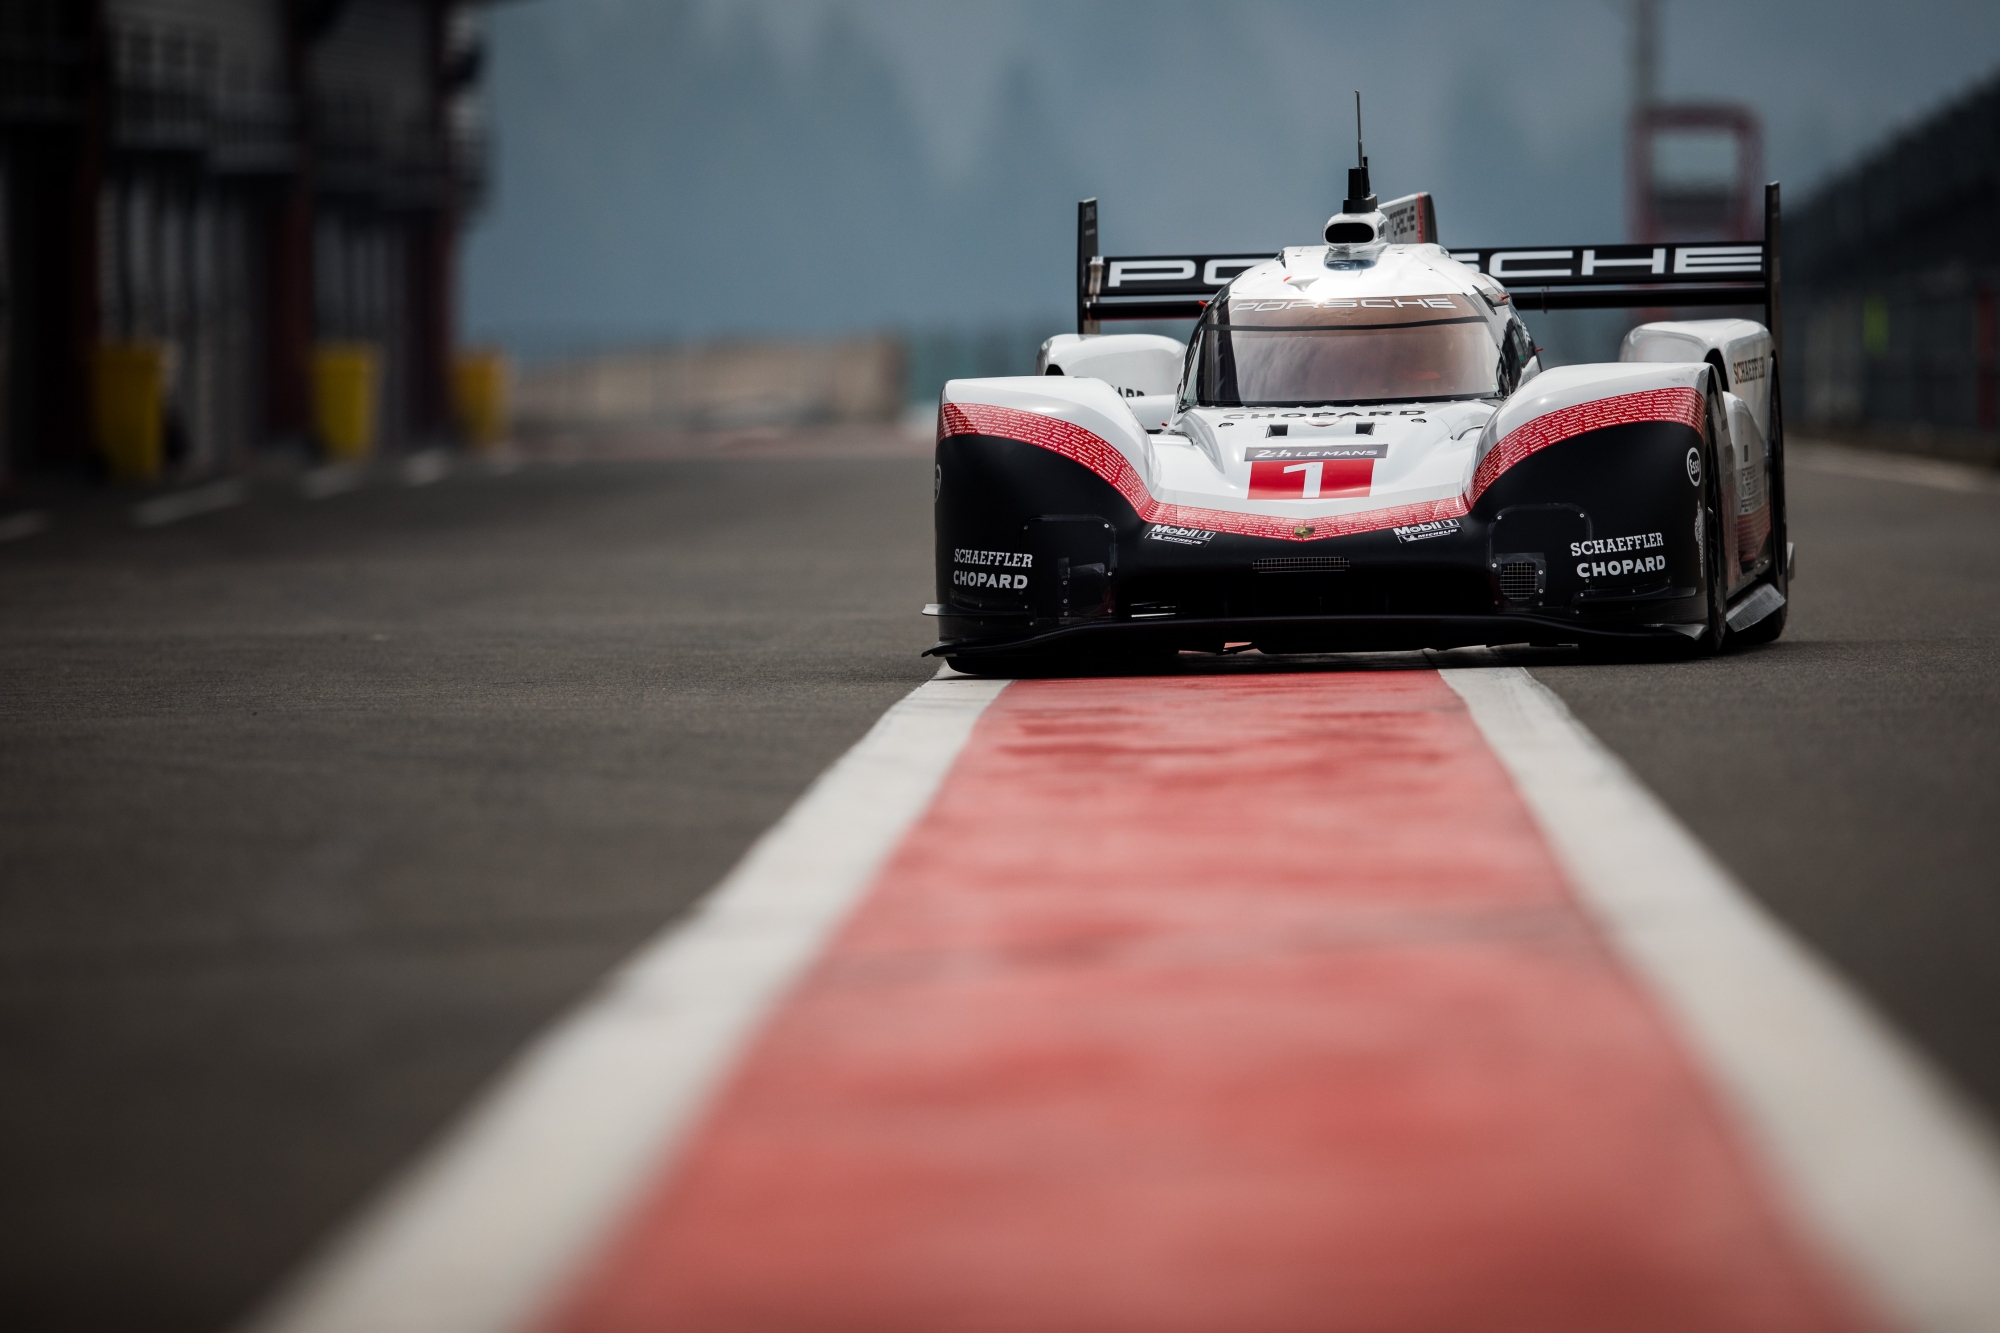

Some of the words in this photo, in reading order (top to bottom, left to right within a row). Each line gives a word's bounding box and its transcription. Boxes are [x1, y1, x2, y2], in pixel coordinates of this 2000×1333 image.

[1107, 246, 1764, 288] POCHE
[1230, 298, 1457, 314] PORSCHE
[1732, 356, 1766, 385] SCHAEFFLER
[1223, 410, 1426, 420] CHOPARD
[1323, 449, 1378, 457] MANS
[1283, 461, 1324, 499] 1
[1150, 524, 1199, 537] Mobil
[1393, 521, 1442, 535] Mobil
[1417, 528, 1458, 538] MICHELIN
[1164, 536, 1203, 545] MICHELIN
[1570, 532, 1664, 557] SCHAEFFLER
[954, 548, 1033, 568] SCHAEFFLER
[1576, 555, 1666, 578] CHOPARD
[953, 570, 1028, 590] CHOPARD
